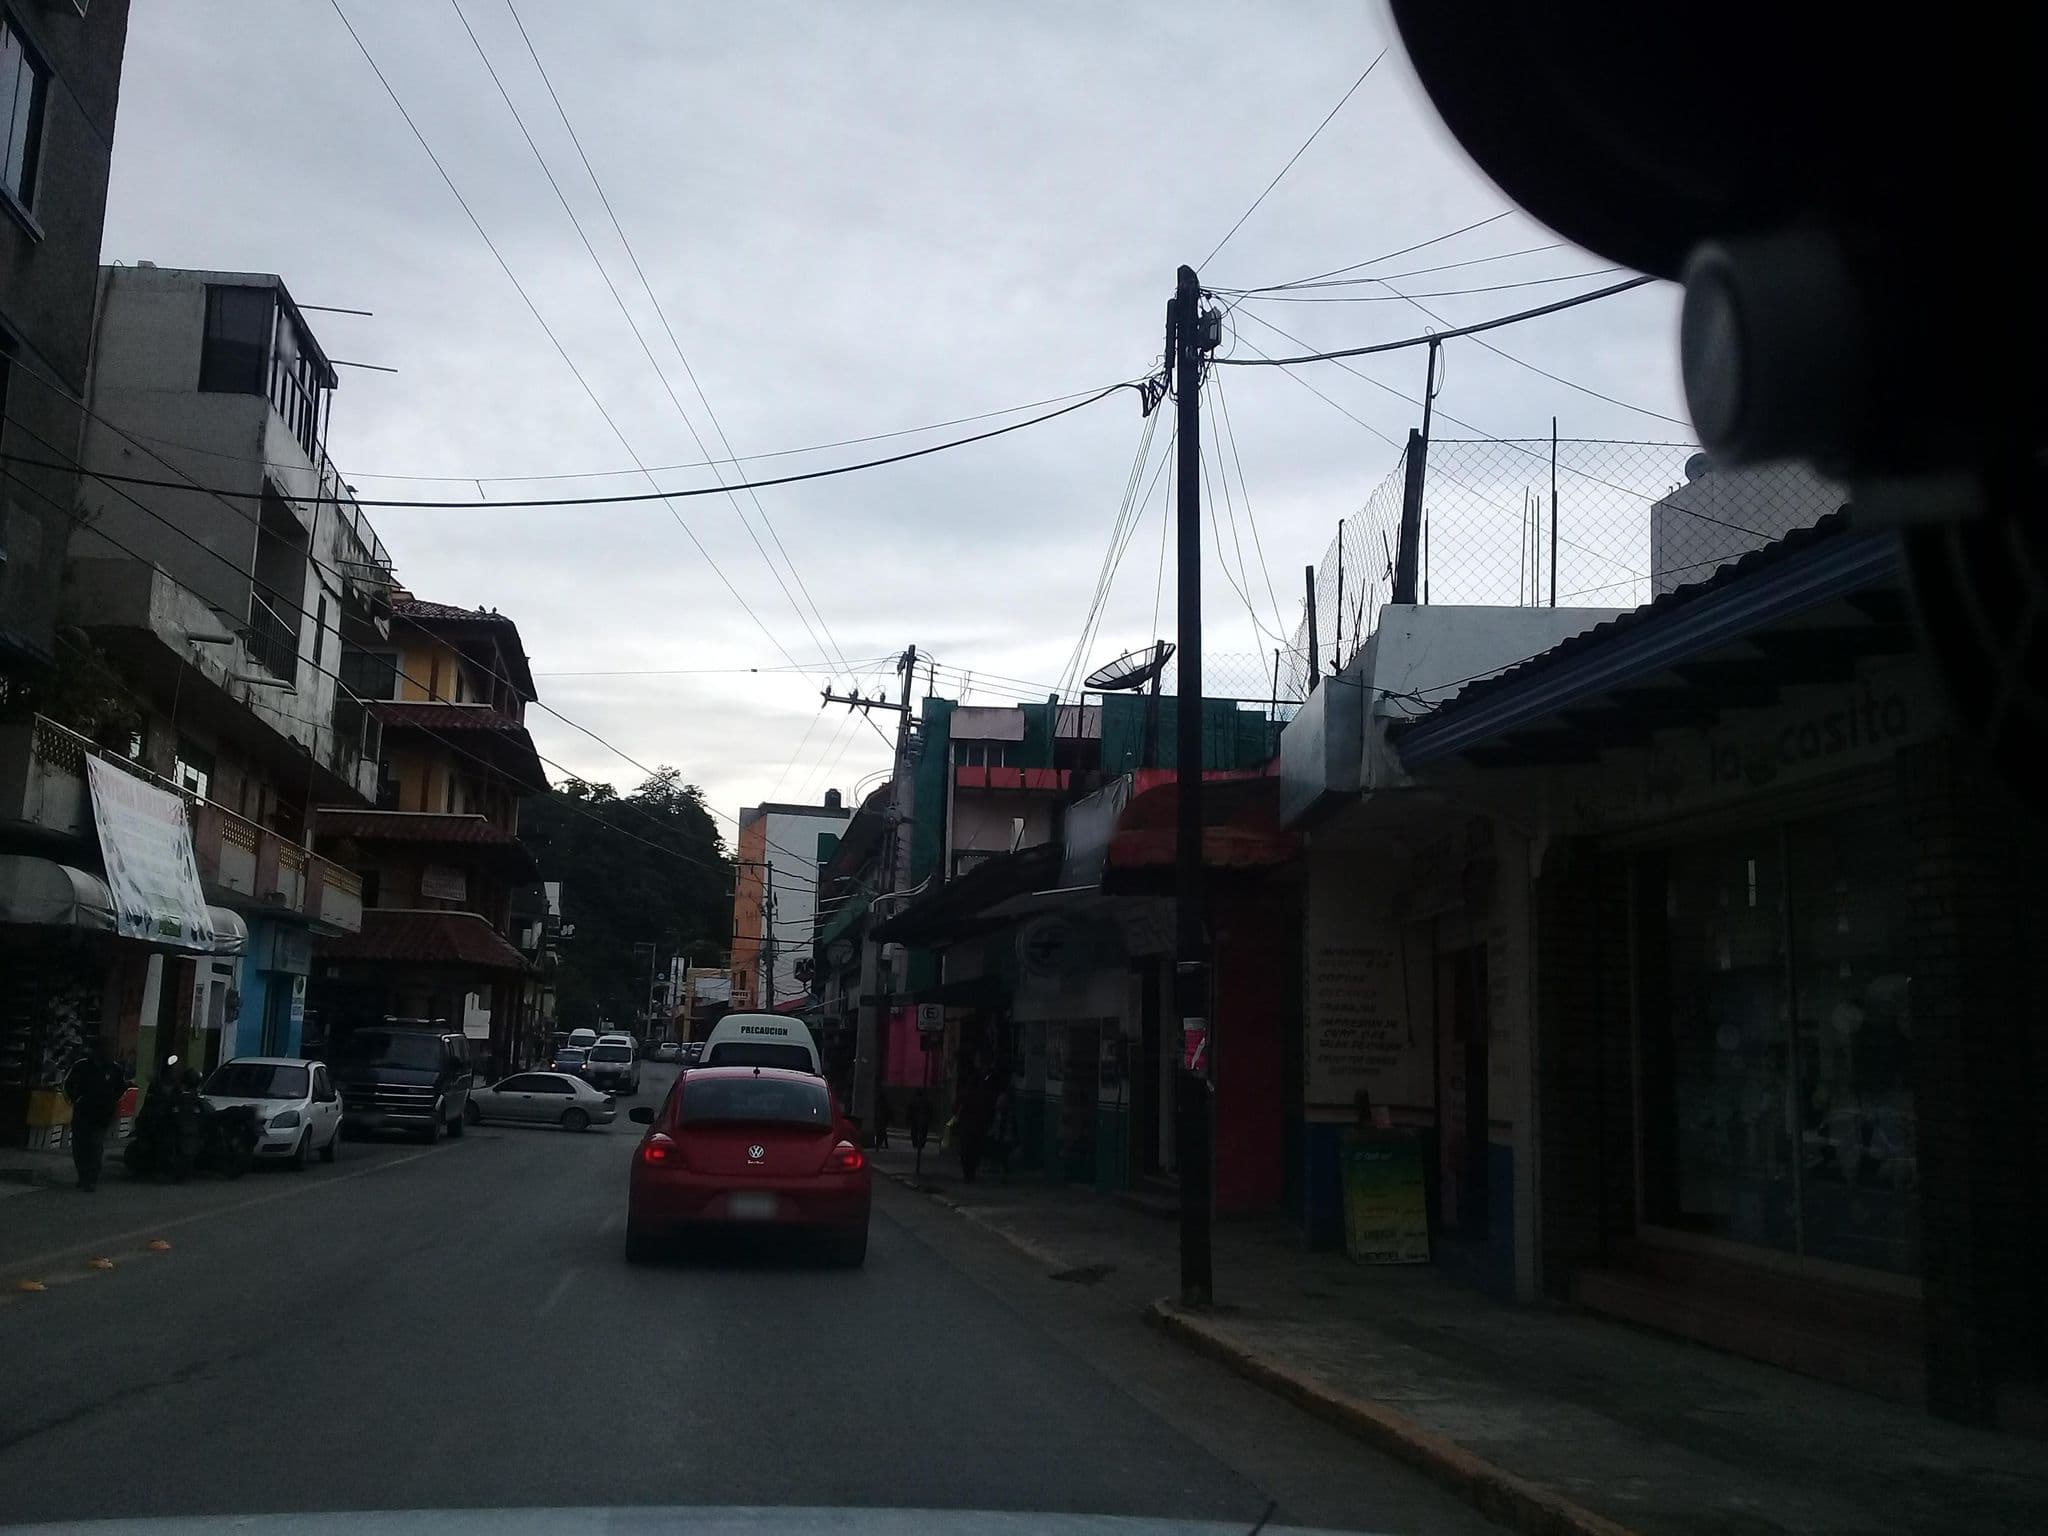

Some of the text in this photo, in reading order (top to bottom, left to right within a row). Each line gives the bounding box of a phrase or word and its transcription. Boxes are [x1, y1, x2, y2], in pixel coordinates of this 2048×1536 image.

[1776, 684, 1908, 764] casita
[925, 1007, 935, 1019] E
[741, 1026, 788, 1036] PRECAUCION
